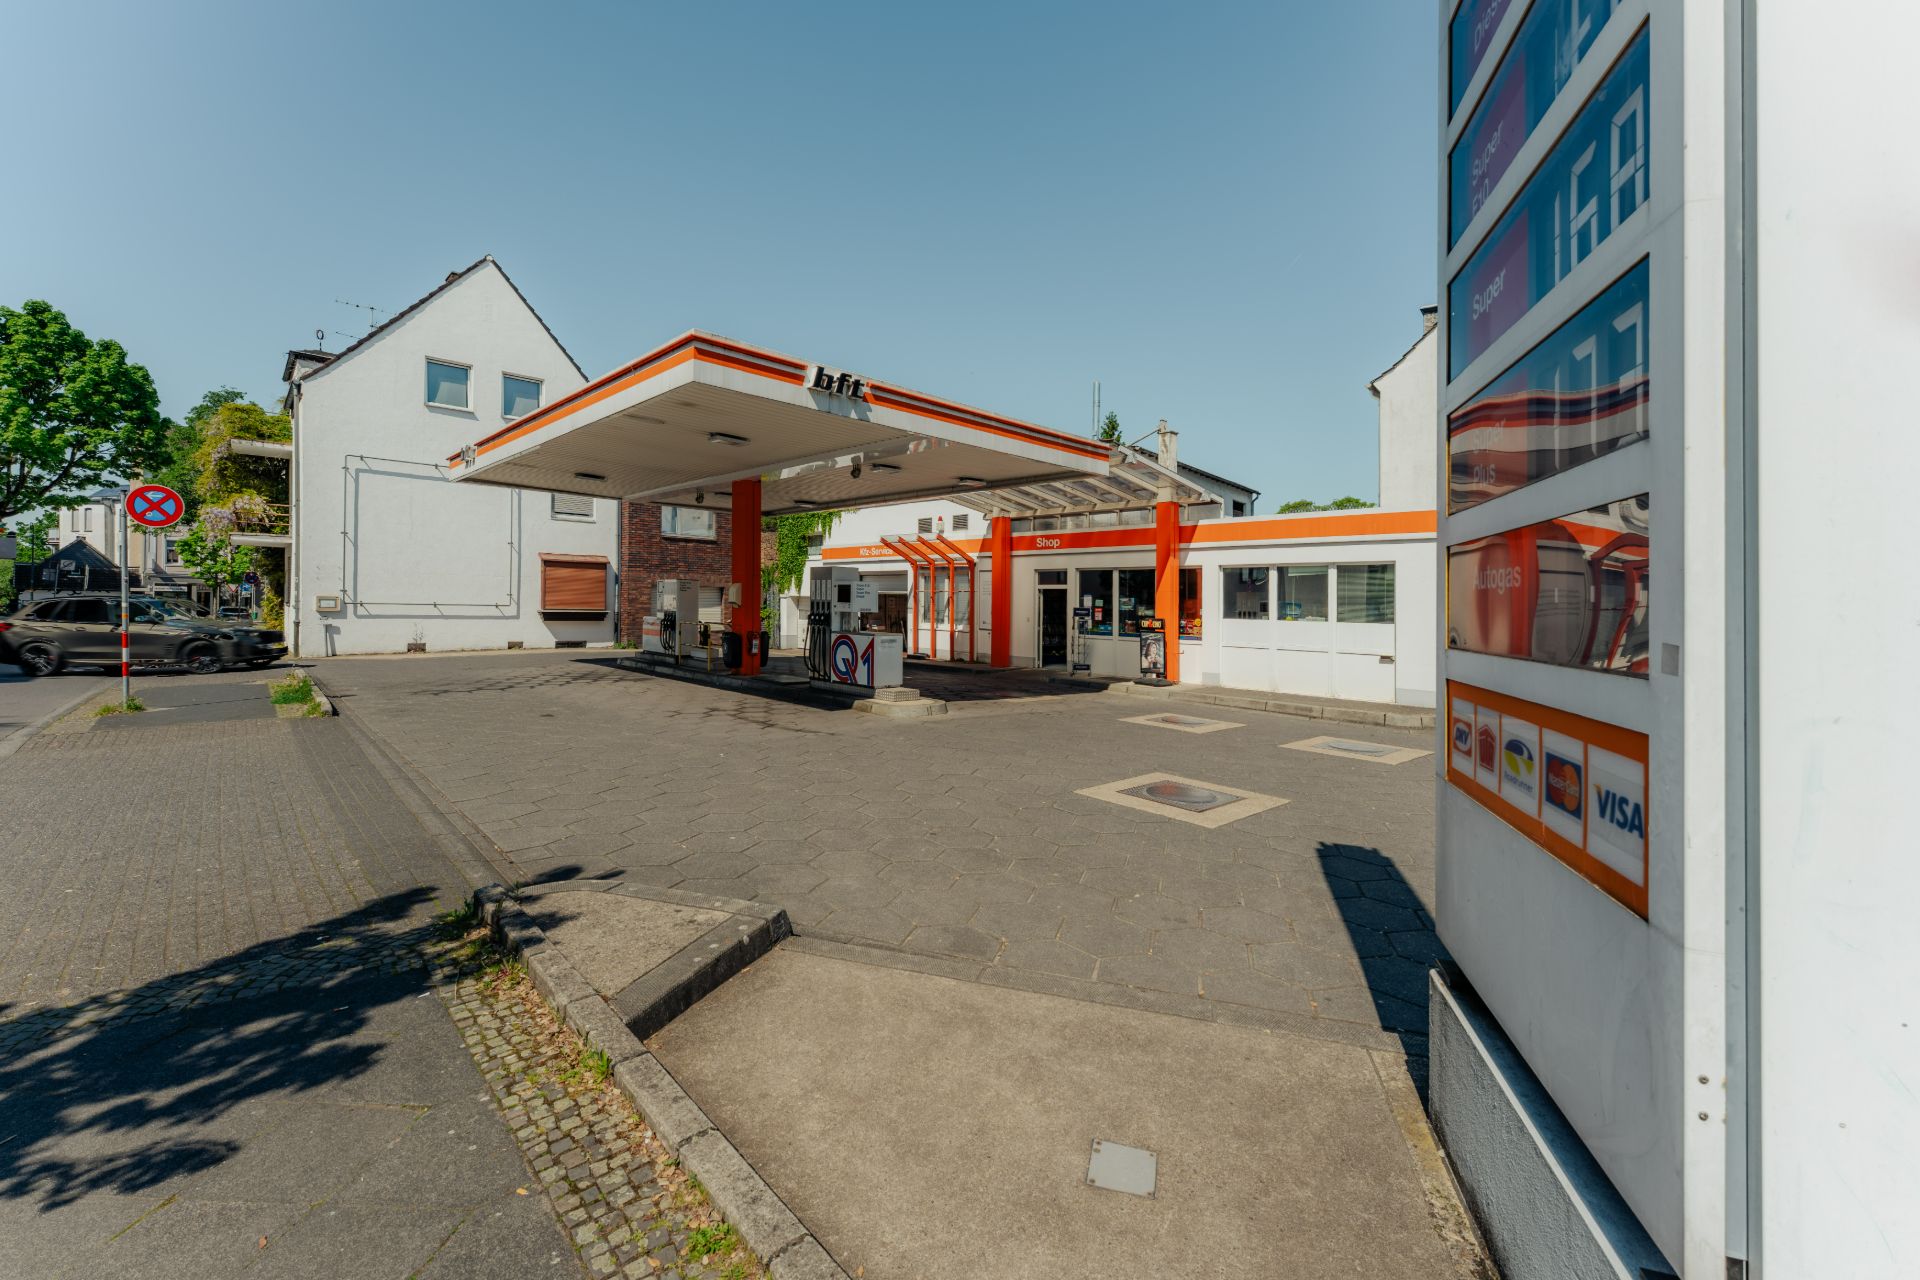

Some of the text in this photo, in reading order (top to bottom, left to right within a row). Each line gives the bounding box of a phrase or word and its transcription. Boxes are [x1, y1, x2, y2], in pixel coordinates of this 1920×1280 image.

[1474, 0, 1501, 55] Dies
[1472, 119, 1503, 186] Super
[1473, 267, 1506, 320] Super
[812, 366, 866, 399] bft
[1473, 418, 1506, 453] Super
[1473, 463, 1496, 487] plus
[1036, 537, 1061, 549] Shop
[1472, 563, 1521, 594] Autogas
[831, 634, 875, 688] Q1
[1593, 784, 1644, 840] VISA
